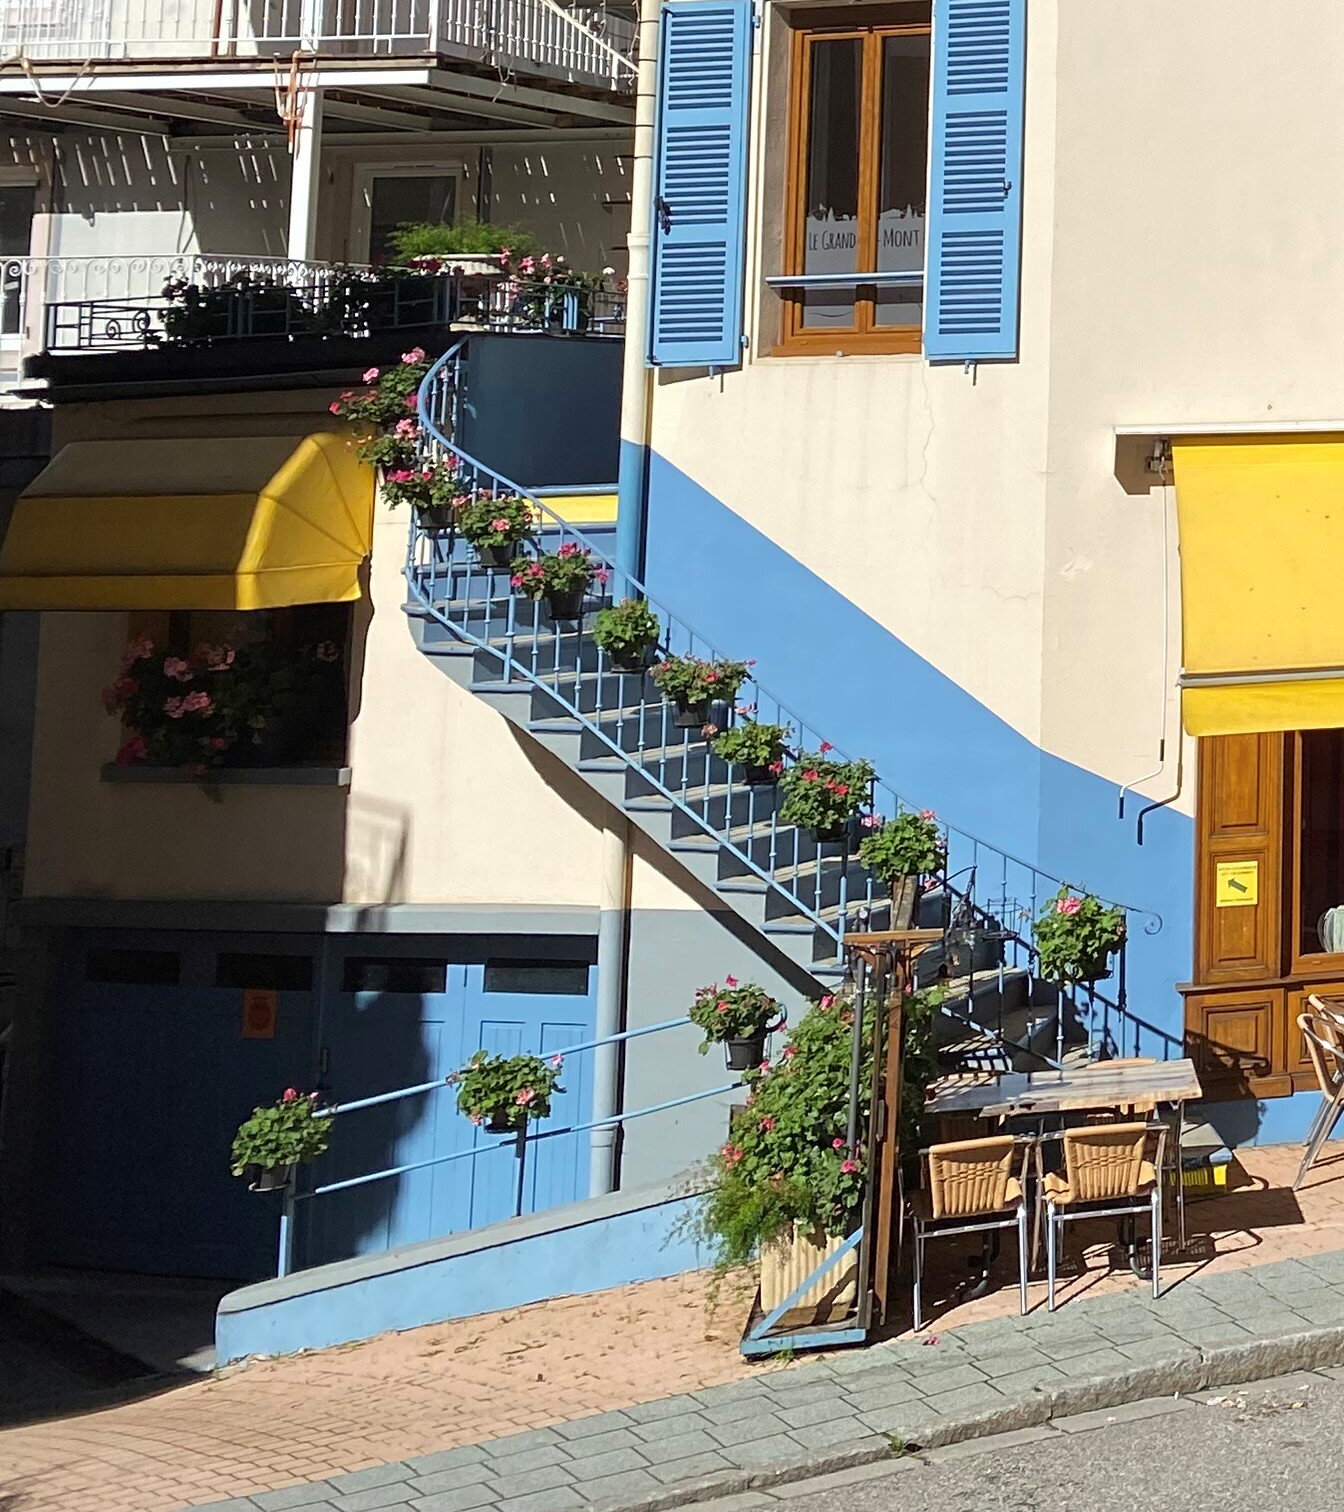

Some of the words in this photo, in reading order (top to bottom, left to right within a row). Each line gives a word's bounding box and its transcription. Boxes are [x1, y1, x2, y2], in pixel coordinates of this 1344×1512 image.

[809, 232, 818, 250] LE
[822, 231, 855, 250] GRAND
[883, 228, 920, 248] MONT
